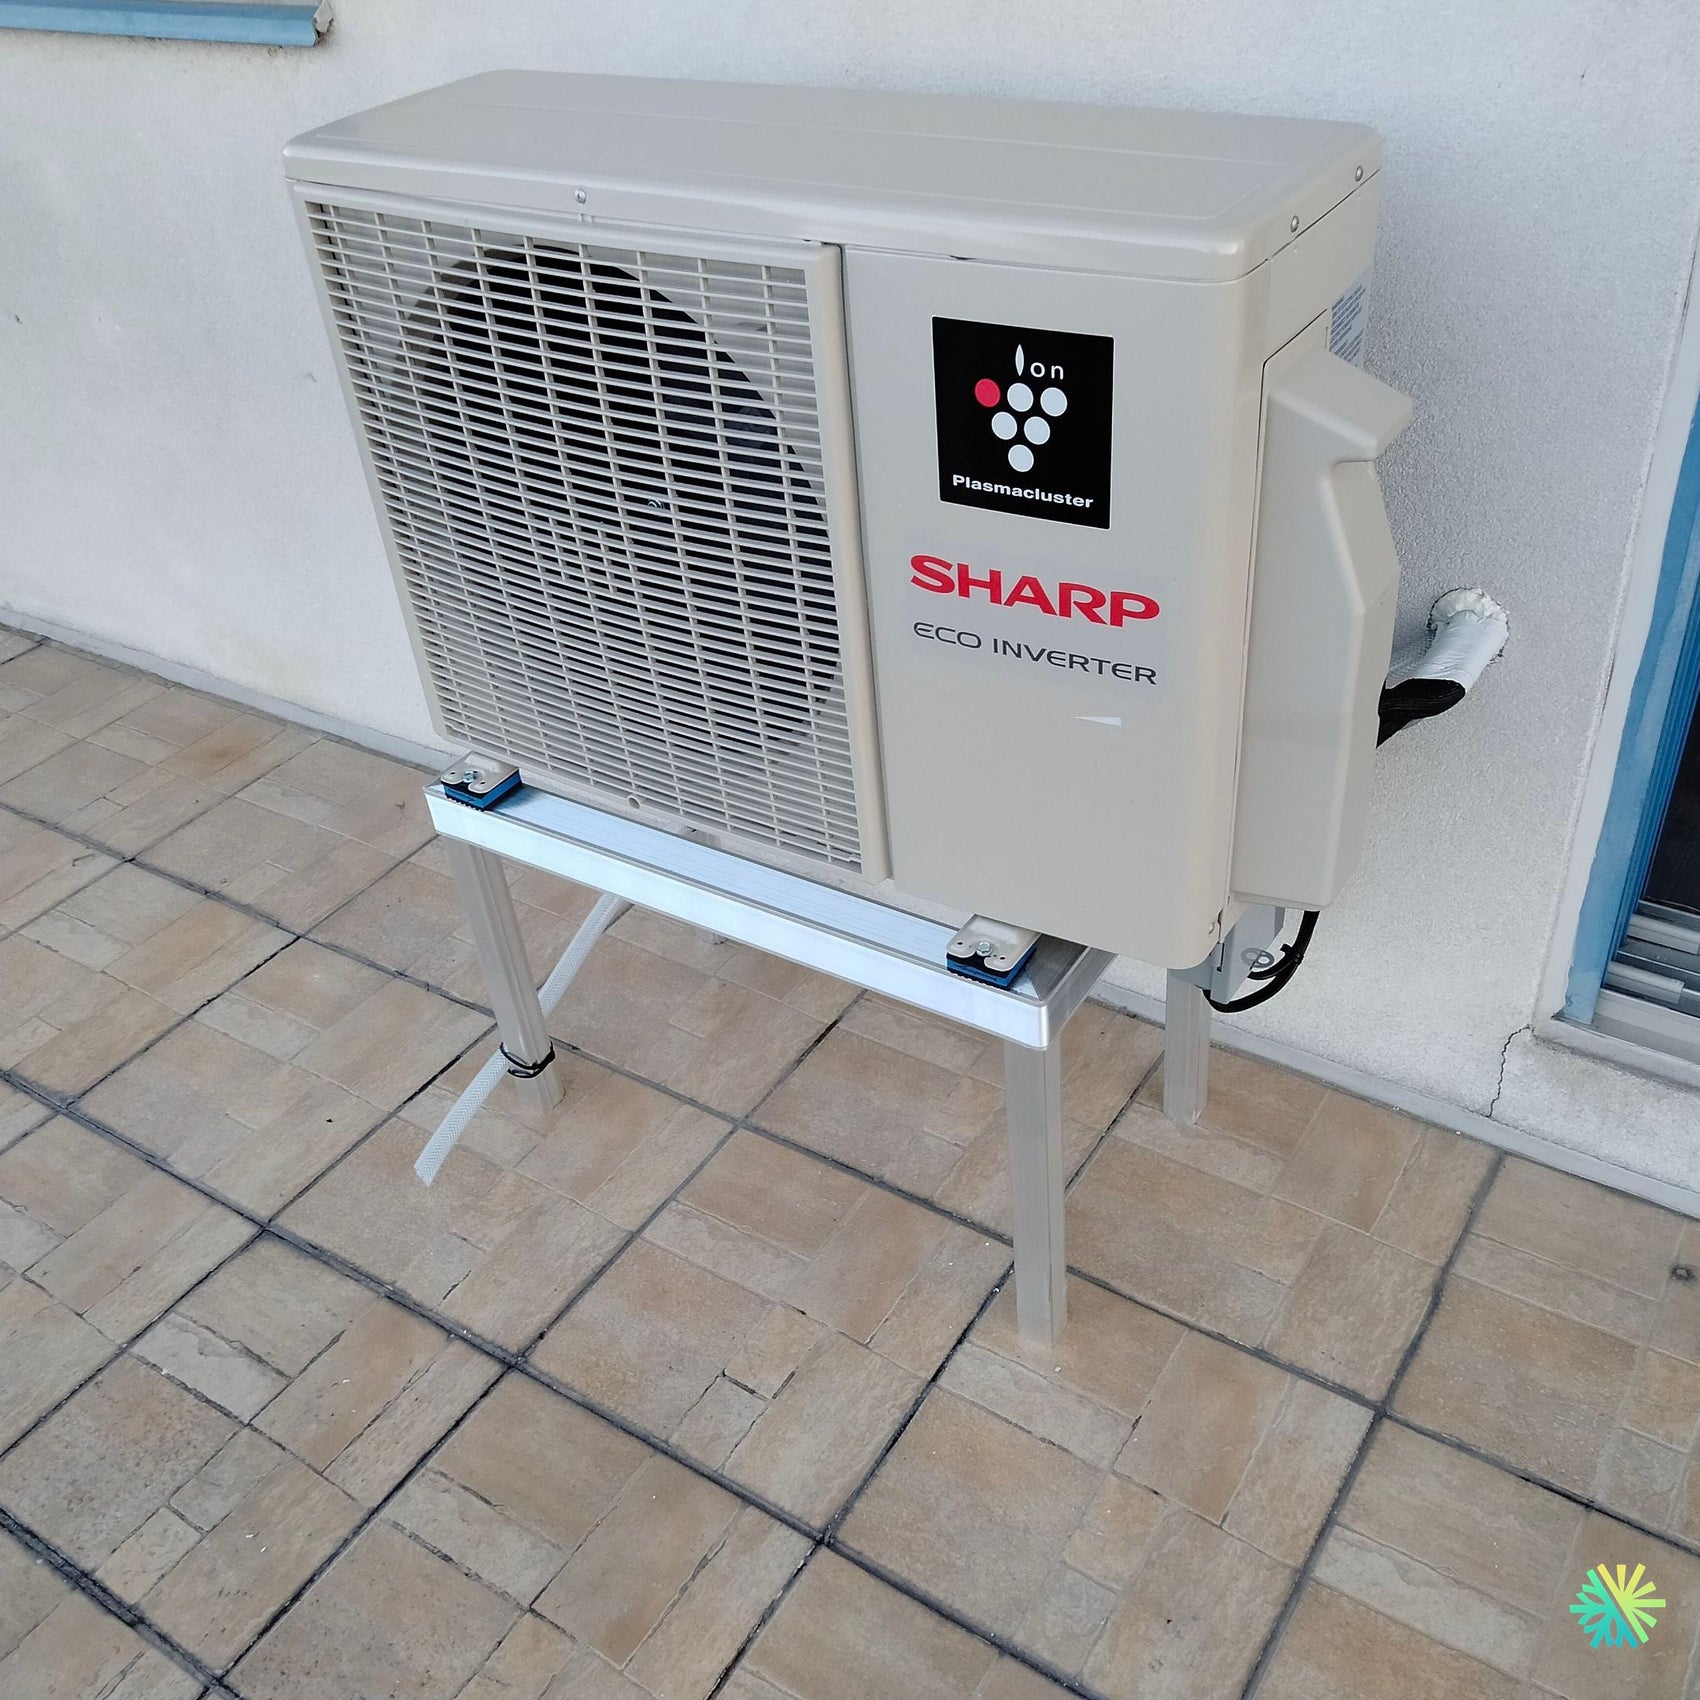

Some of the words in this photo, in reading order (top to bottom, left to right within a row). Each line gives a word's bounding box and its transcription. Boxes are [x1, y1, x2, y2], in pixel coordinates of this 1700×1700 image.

[1015, 344, 1064, 380] Ion
[952, 474, 1094, 508] Plasmacluster
[911, 555, 1160, 627] SHARP
[913, 621, 982, 650] ECO
[992, 637, 1158, 686] INVERTER
